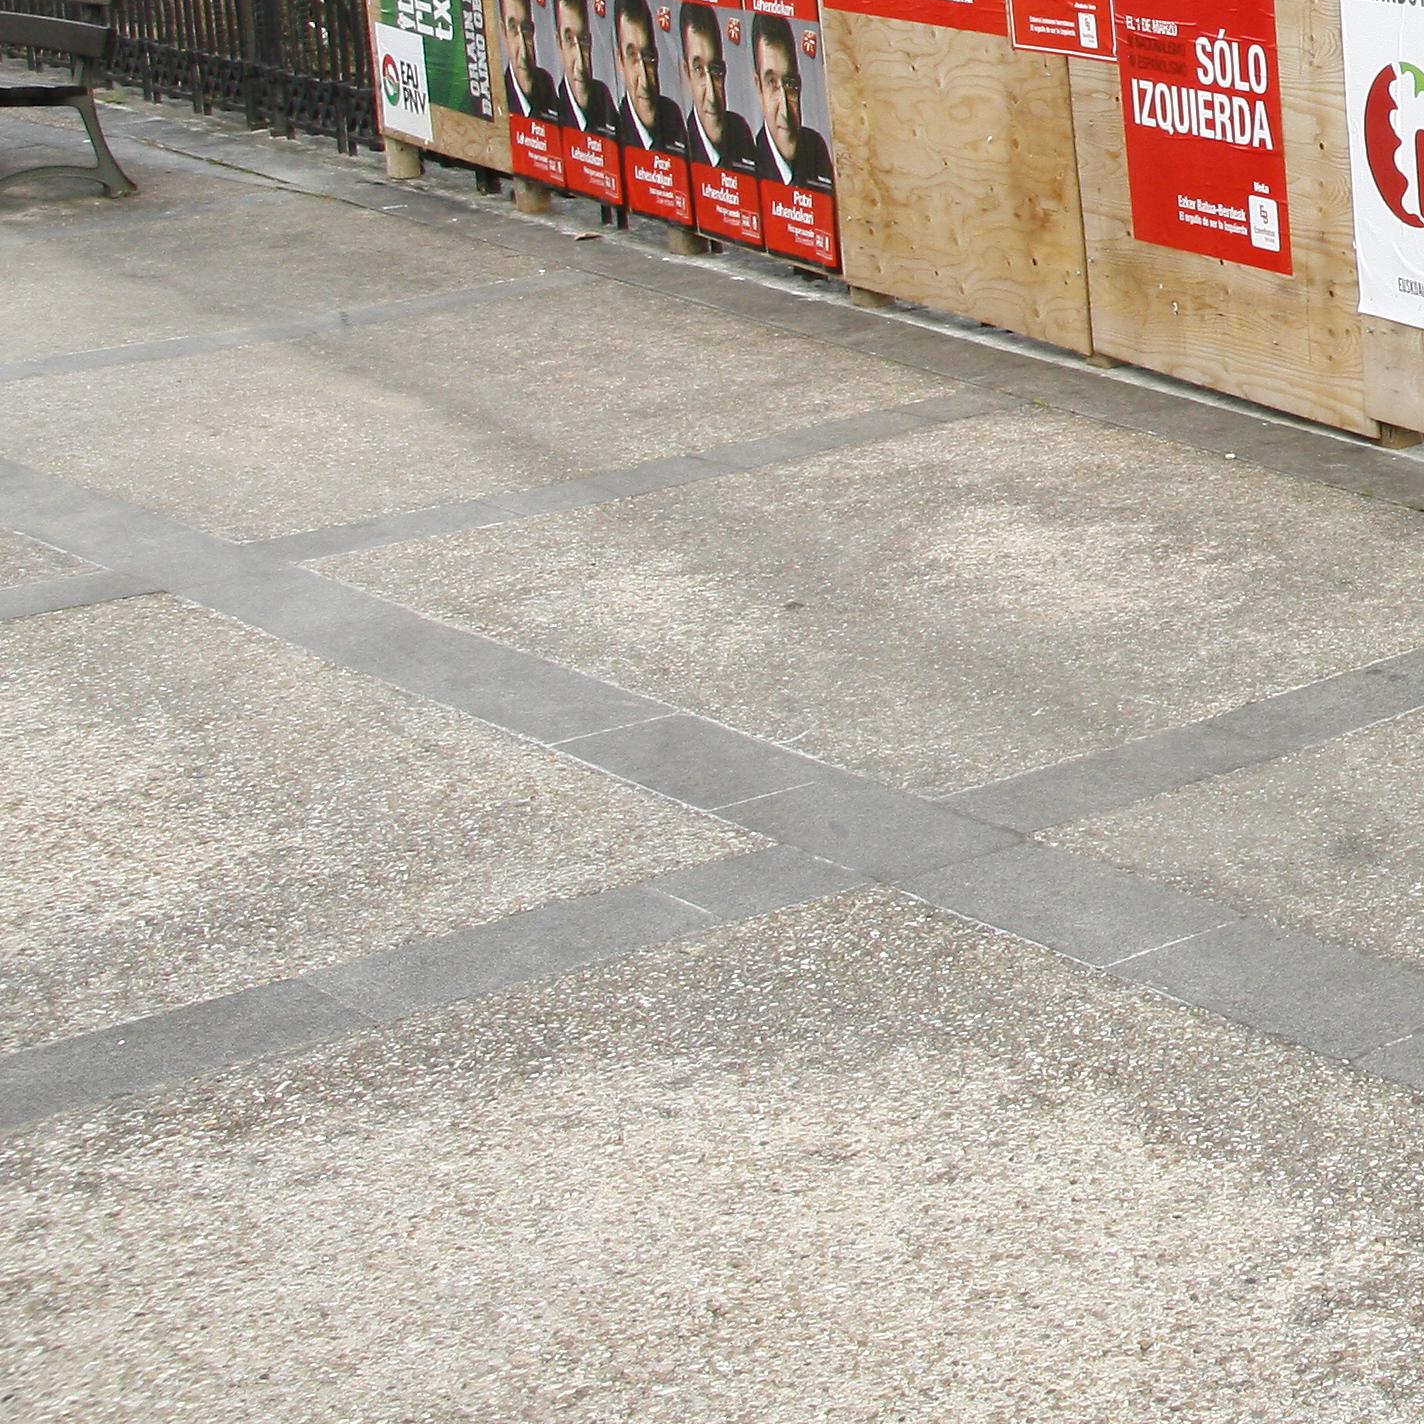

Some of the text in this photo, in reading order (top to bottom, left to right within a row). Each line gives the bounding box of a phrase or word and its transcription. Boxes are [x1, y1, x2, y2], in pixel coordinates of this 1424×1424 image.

[400, 61, 419, 89] EAJ
[1195, 28, 1268, 95] SÓLO
[403, 87, 427, 116] PNV
[1131, 78, 1274, 151] IZQUIERDA
